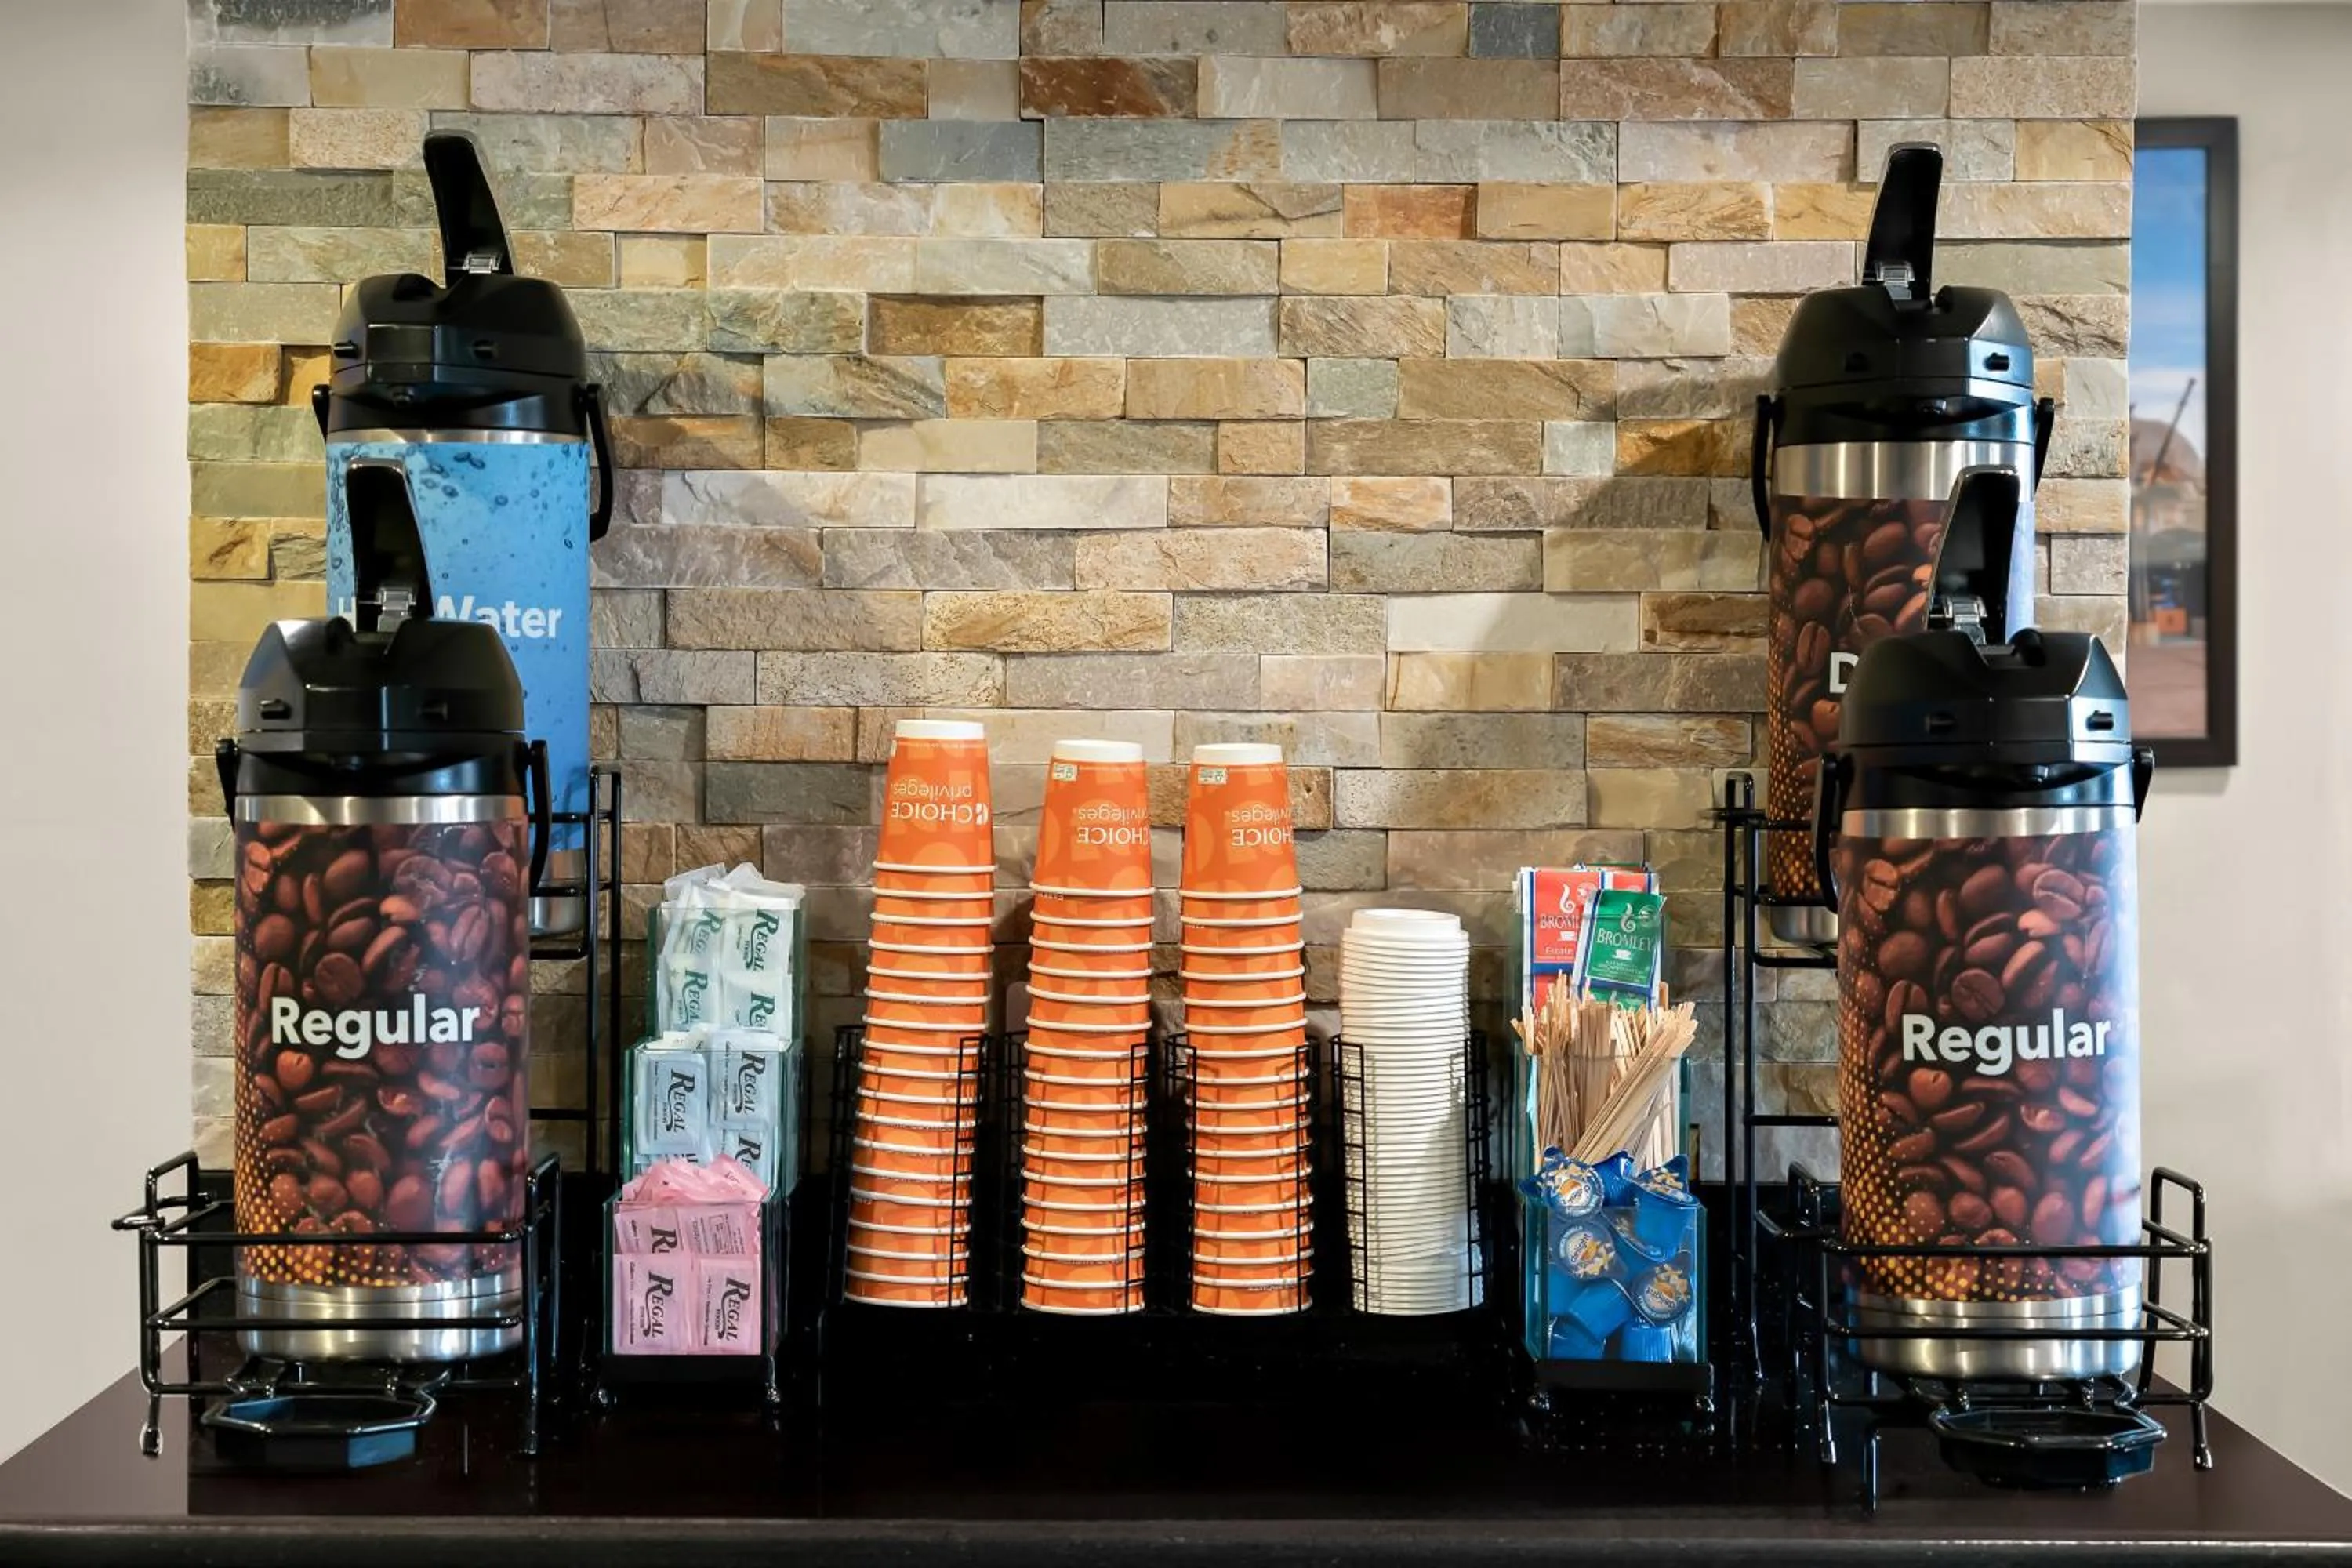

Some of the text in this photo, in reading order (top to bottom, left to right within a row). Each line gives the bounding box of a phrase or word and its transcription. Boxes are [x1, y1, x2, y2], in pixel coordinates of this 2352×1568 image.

[890, 800, 972, 825] CHOICE
[1232, 824, 1294, 847] HOICE
[690, 909, 725, 955] REG
[746, 908, 780, 972] REGAL
[1539, 913, 1581, 930] BROML
[270, 993, 481, 1060] Regular
[1901, 1007, 2111, 1076] Regular
[666, 1069, 696, 1134] REGAL
[735, 1051, 766, 1115] REGAL
[643, 1271, 673, 1338] REGAL
[717, 1276, 751, 1341] REGAL
